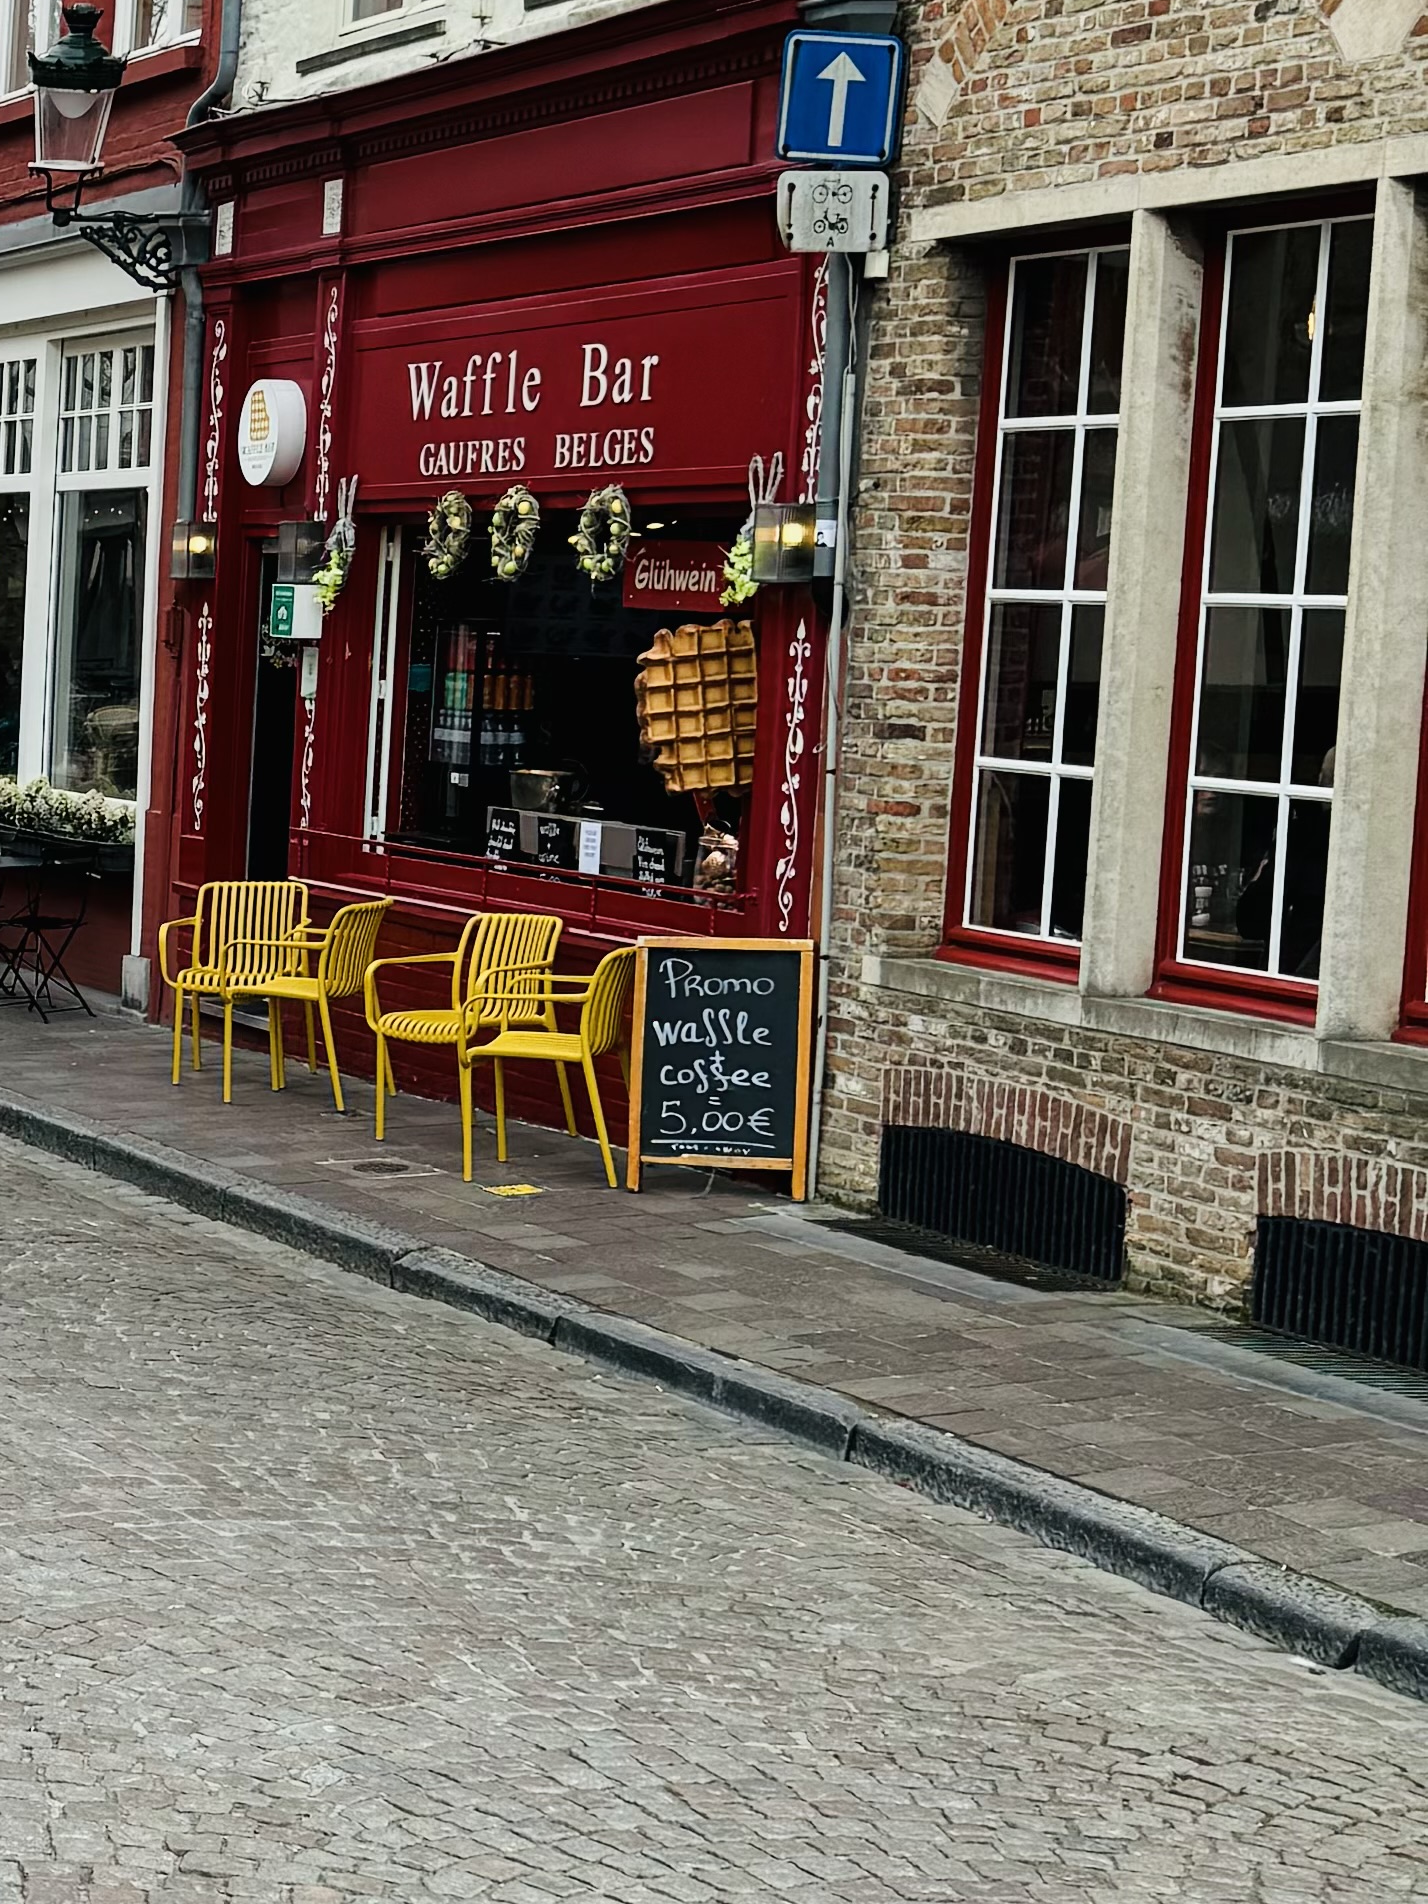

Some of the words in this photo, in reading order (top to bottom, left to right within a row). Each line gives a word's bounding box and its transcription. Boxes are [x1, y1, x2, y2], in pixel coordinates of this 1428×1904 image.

[826, 236, 835, 248] A
[407, 349, 542, 422] Waffle
[579, 342, 660, 408] Bar
[419, 436, 526, 477] GAUFRES
[553, 426, 655, 469] BELGES
[634, 558, 717, 593] Glühwein
[652, 1007, 773, 1048] waffle
[659, 1058, 772, 1094] coffee
